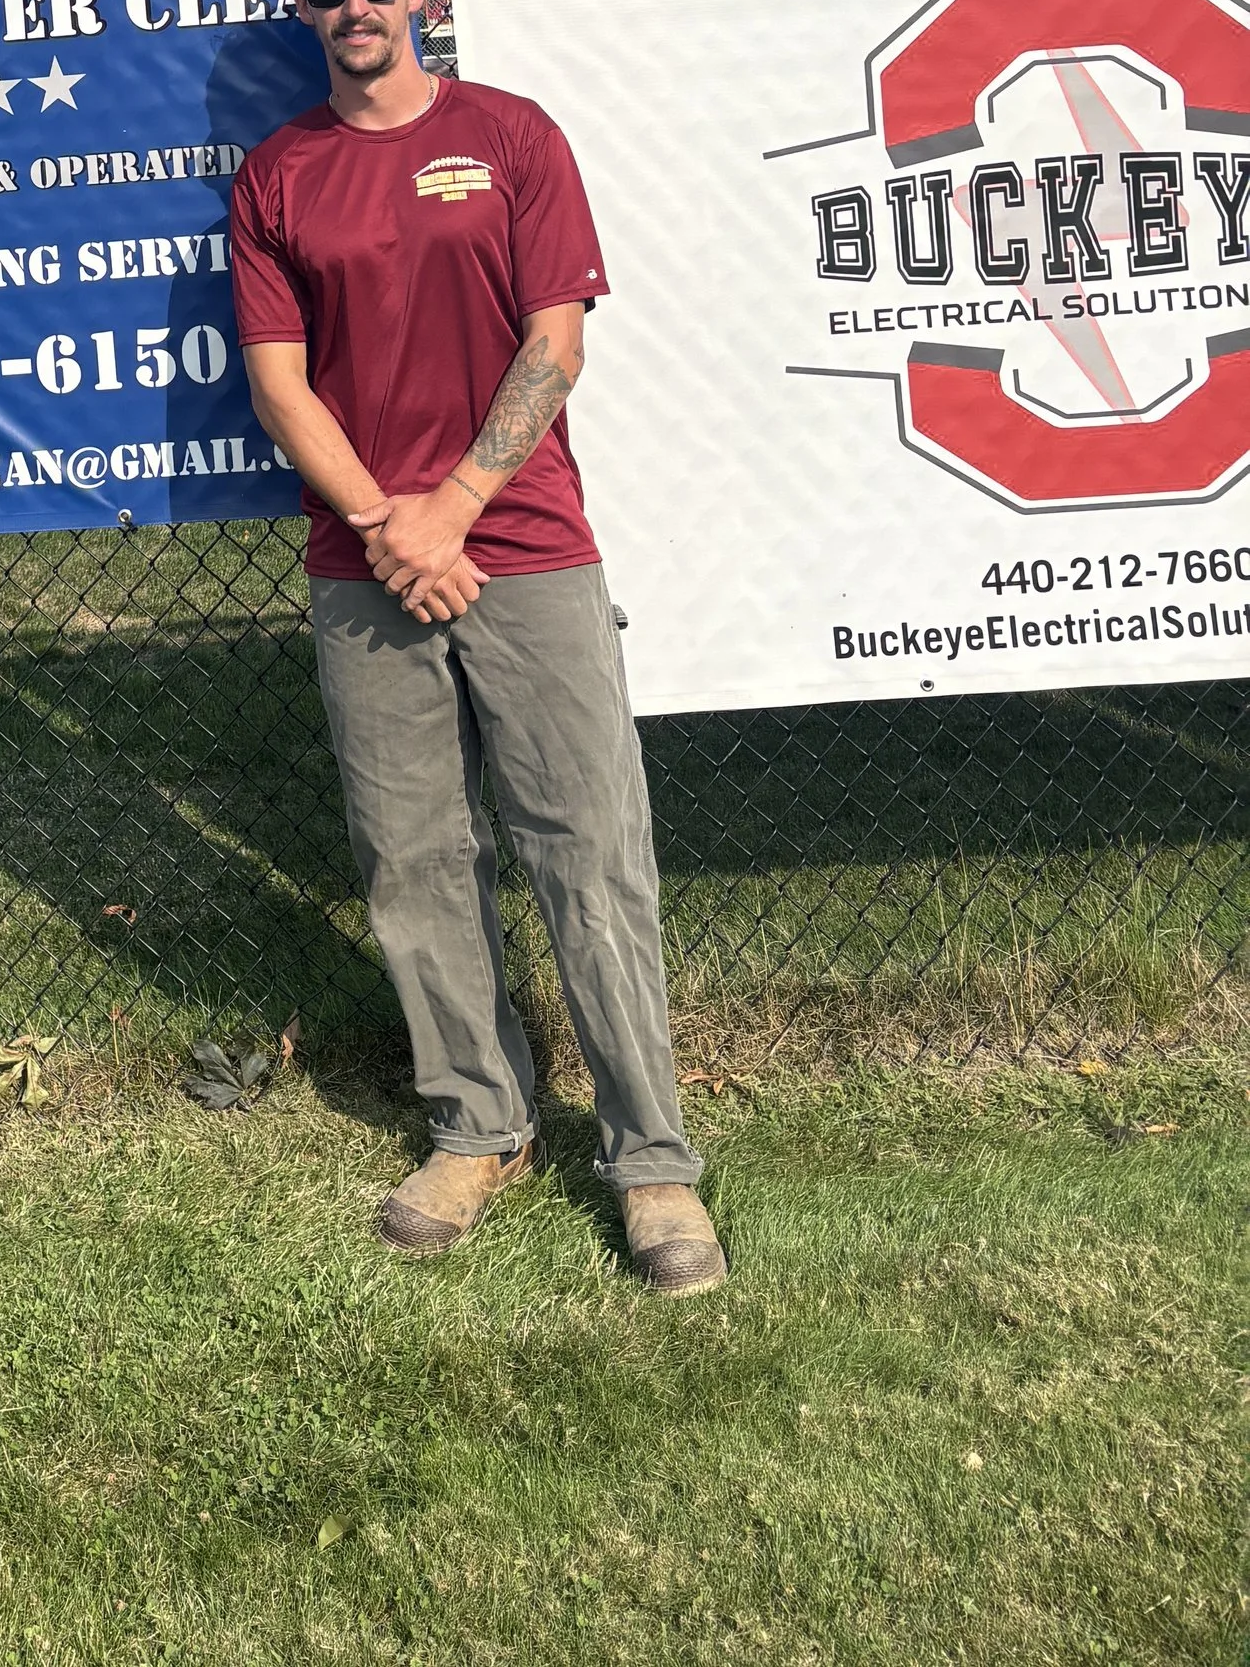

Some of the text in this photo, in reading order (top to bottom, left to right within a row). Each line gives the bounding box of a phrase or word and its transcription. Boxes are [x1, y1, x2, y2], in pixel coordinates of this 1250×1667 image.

[29, 144, 248, 191] OPERATED
[811, 151, 1250, 286] BUCKEY
[77, 233, 233, 283] SERVI
[829, 282, 1250, 335] ELECTRICAL SOLUTION
[981, 547, 1250, 596] 440-212-7660
